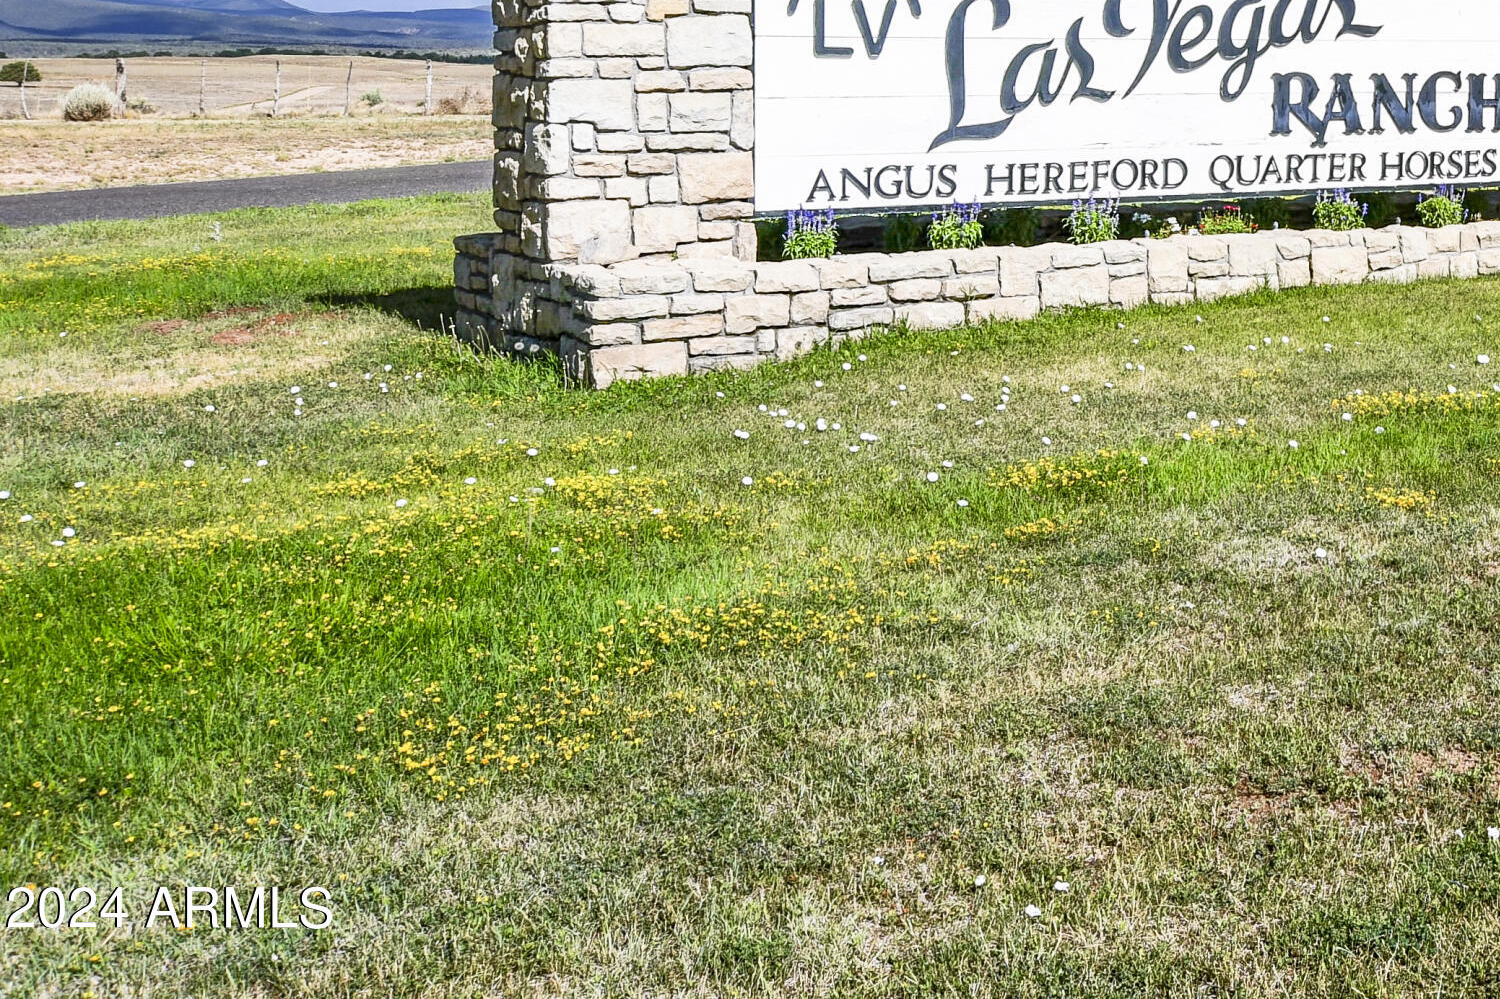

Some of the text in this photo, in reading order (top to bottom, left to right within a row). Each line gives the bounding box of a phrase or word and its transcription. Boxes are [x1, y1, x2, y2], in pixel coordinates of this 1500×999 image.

[806, 147, 1499, 202] ANGUS HEREFORD QUARTER HORSES
